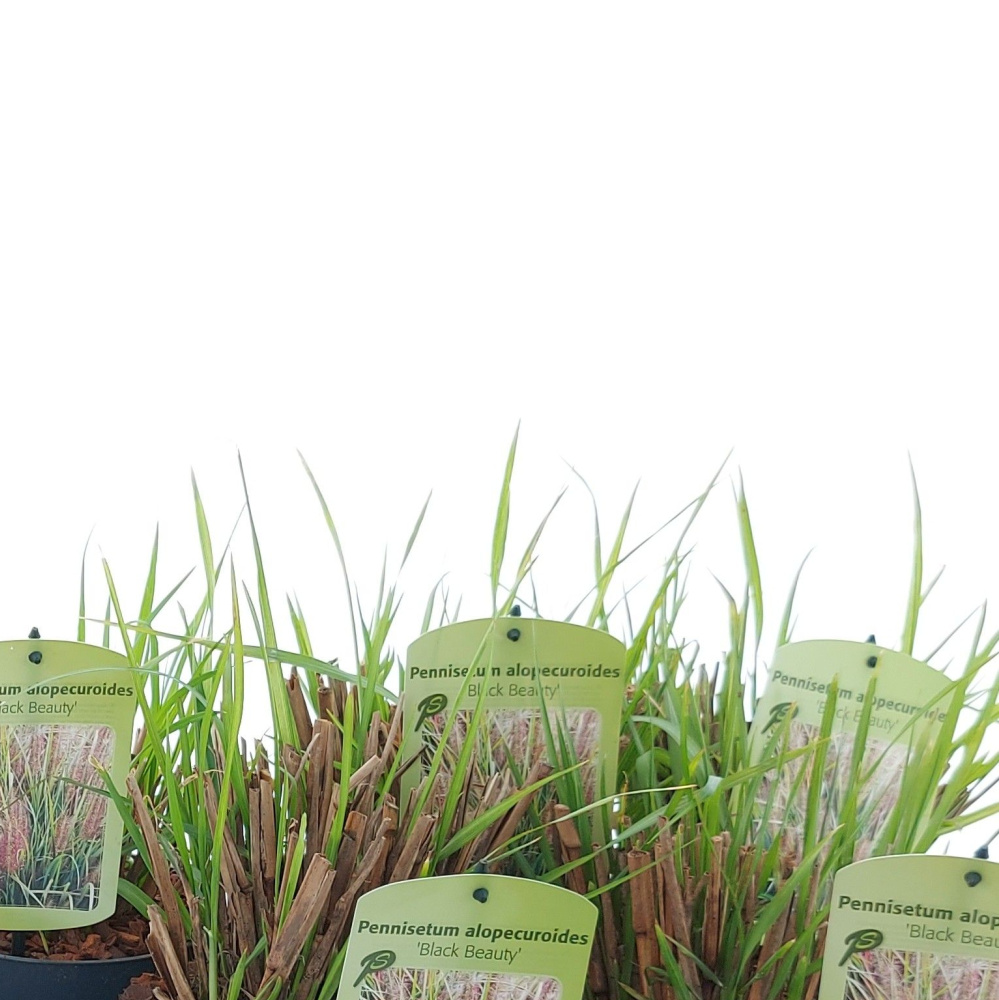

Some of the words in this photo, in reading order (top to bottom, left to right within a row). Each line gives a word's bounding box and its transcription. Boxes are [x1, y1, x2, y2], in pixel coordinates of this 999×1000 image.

[409, 663, 501, 680] Penniseum
[26, 682, 134, 699] alopecuroides
[28, 700, 78, 717] Beauty'
[837, 895, 953, 920] Pennisetum
[357, 920, 460, 937] Pennisetum
[465, 922, 590, 946] alopecuroides
[906, 924, 955, 943] 'Black
[416, 941, 460, 959] 'Black
[464, 944, 523, 965] Beauty'
